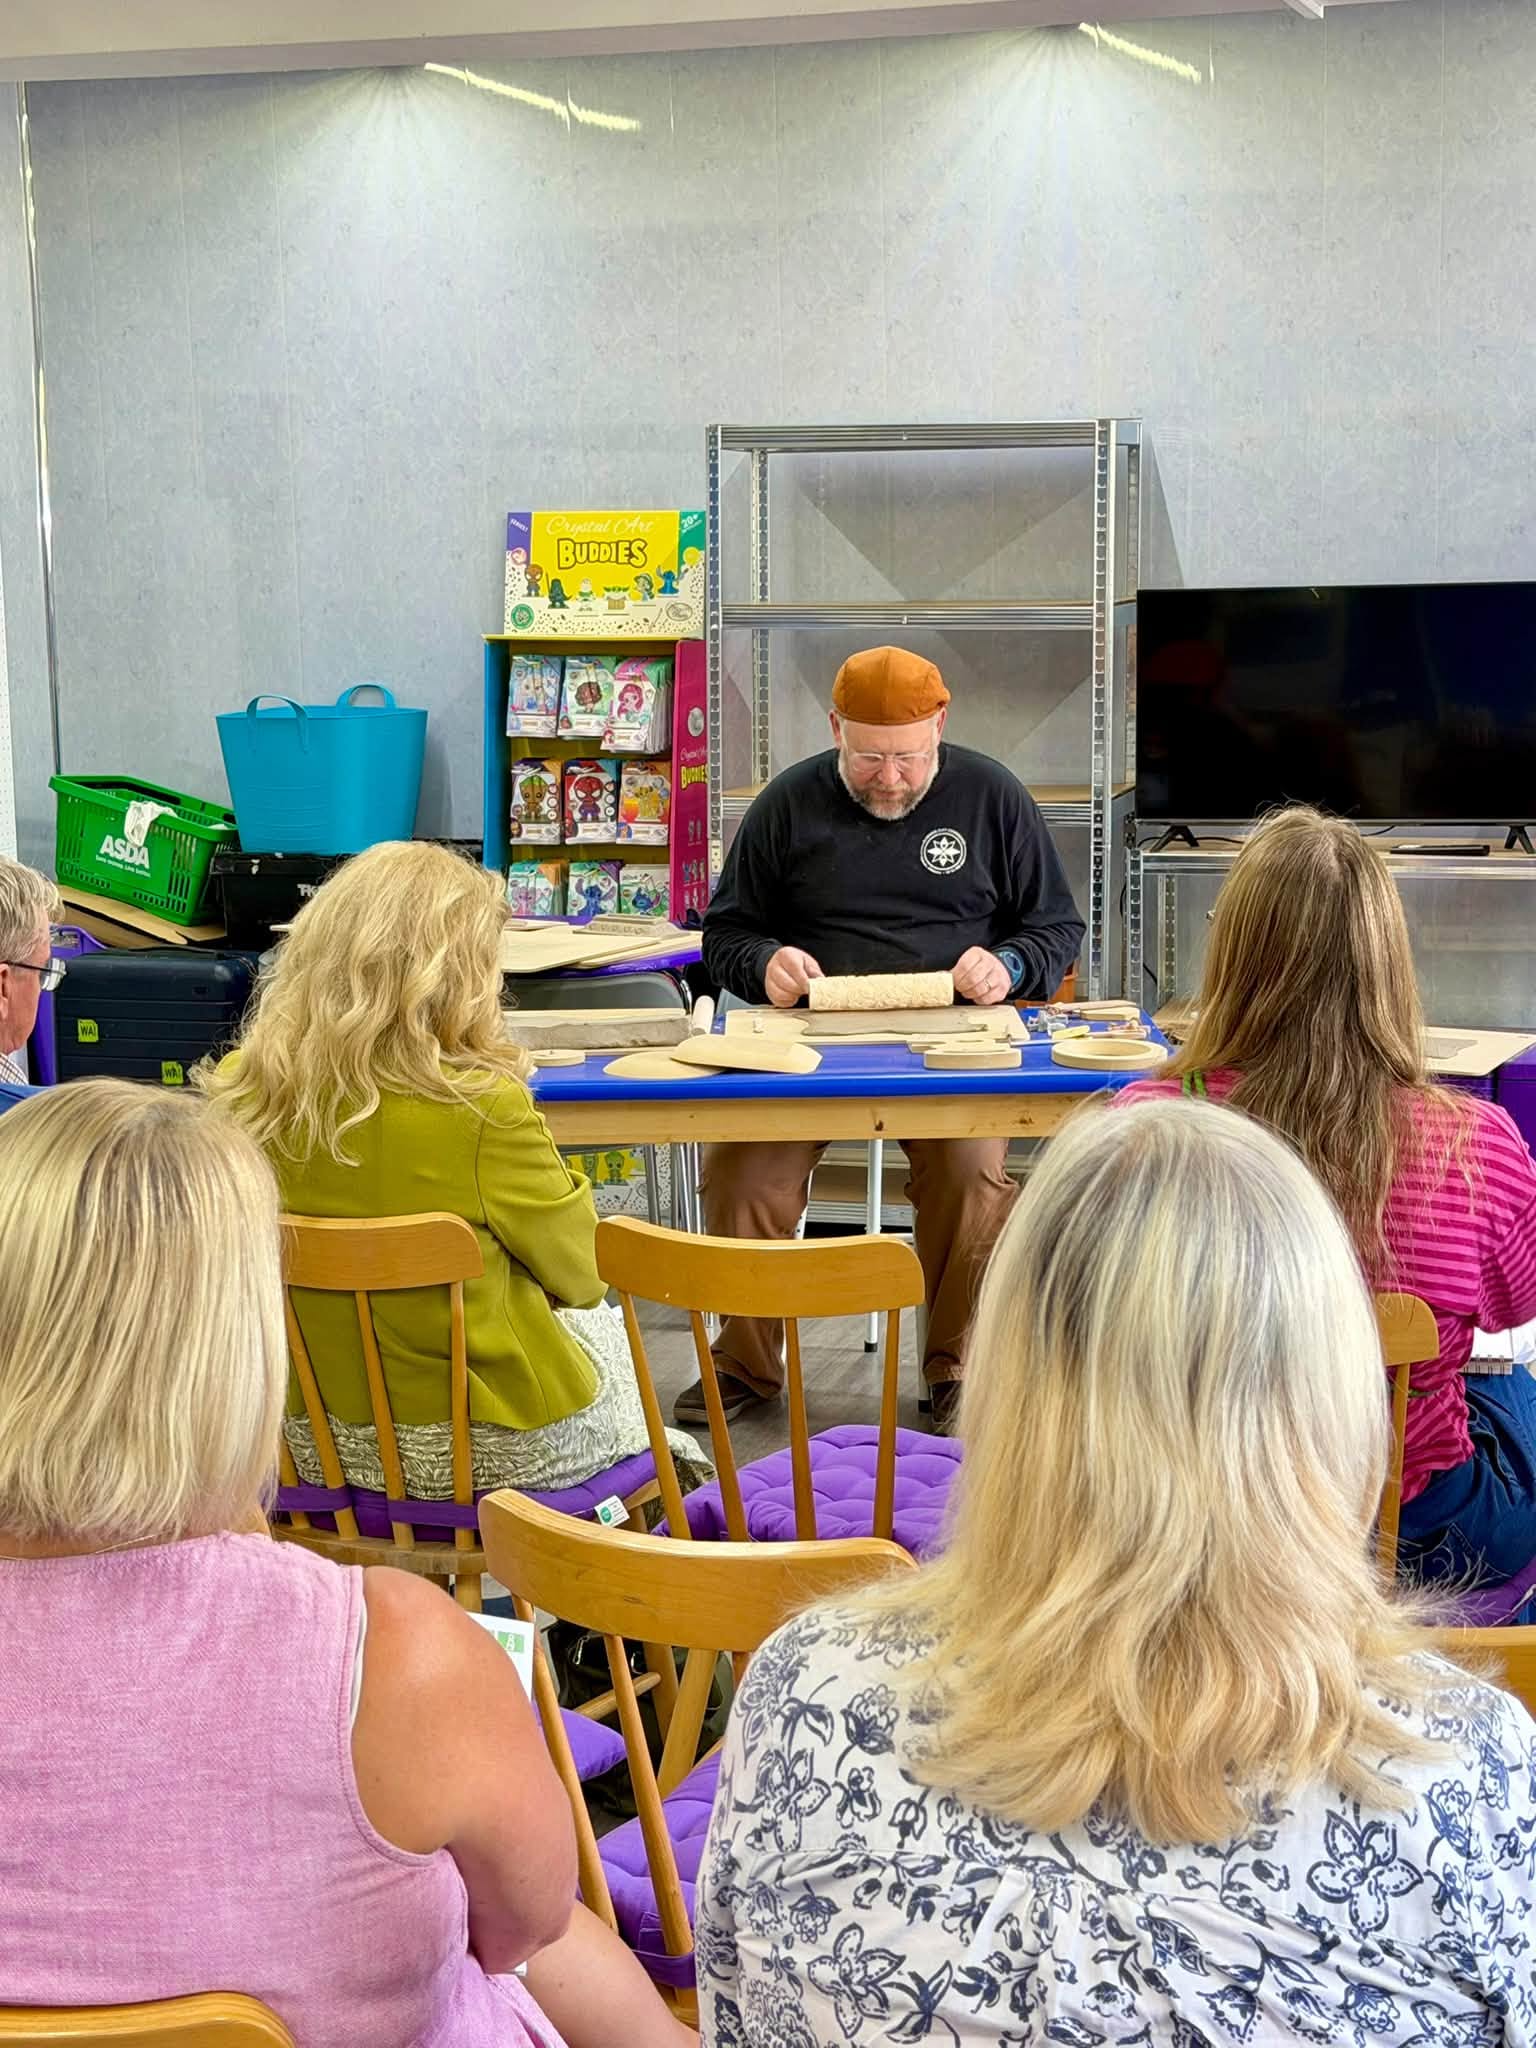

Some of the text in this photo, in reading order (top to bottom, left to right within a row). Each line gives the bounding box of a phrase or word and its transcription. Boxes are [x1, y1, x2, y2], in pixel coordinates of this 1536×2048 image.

[546, 516, 611, 536] Crystal
[557, 538, 648, 570] BUDDIES
[99, 834, 150, 869] ASDA
